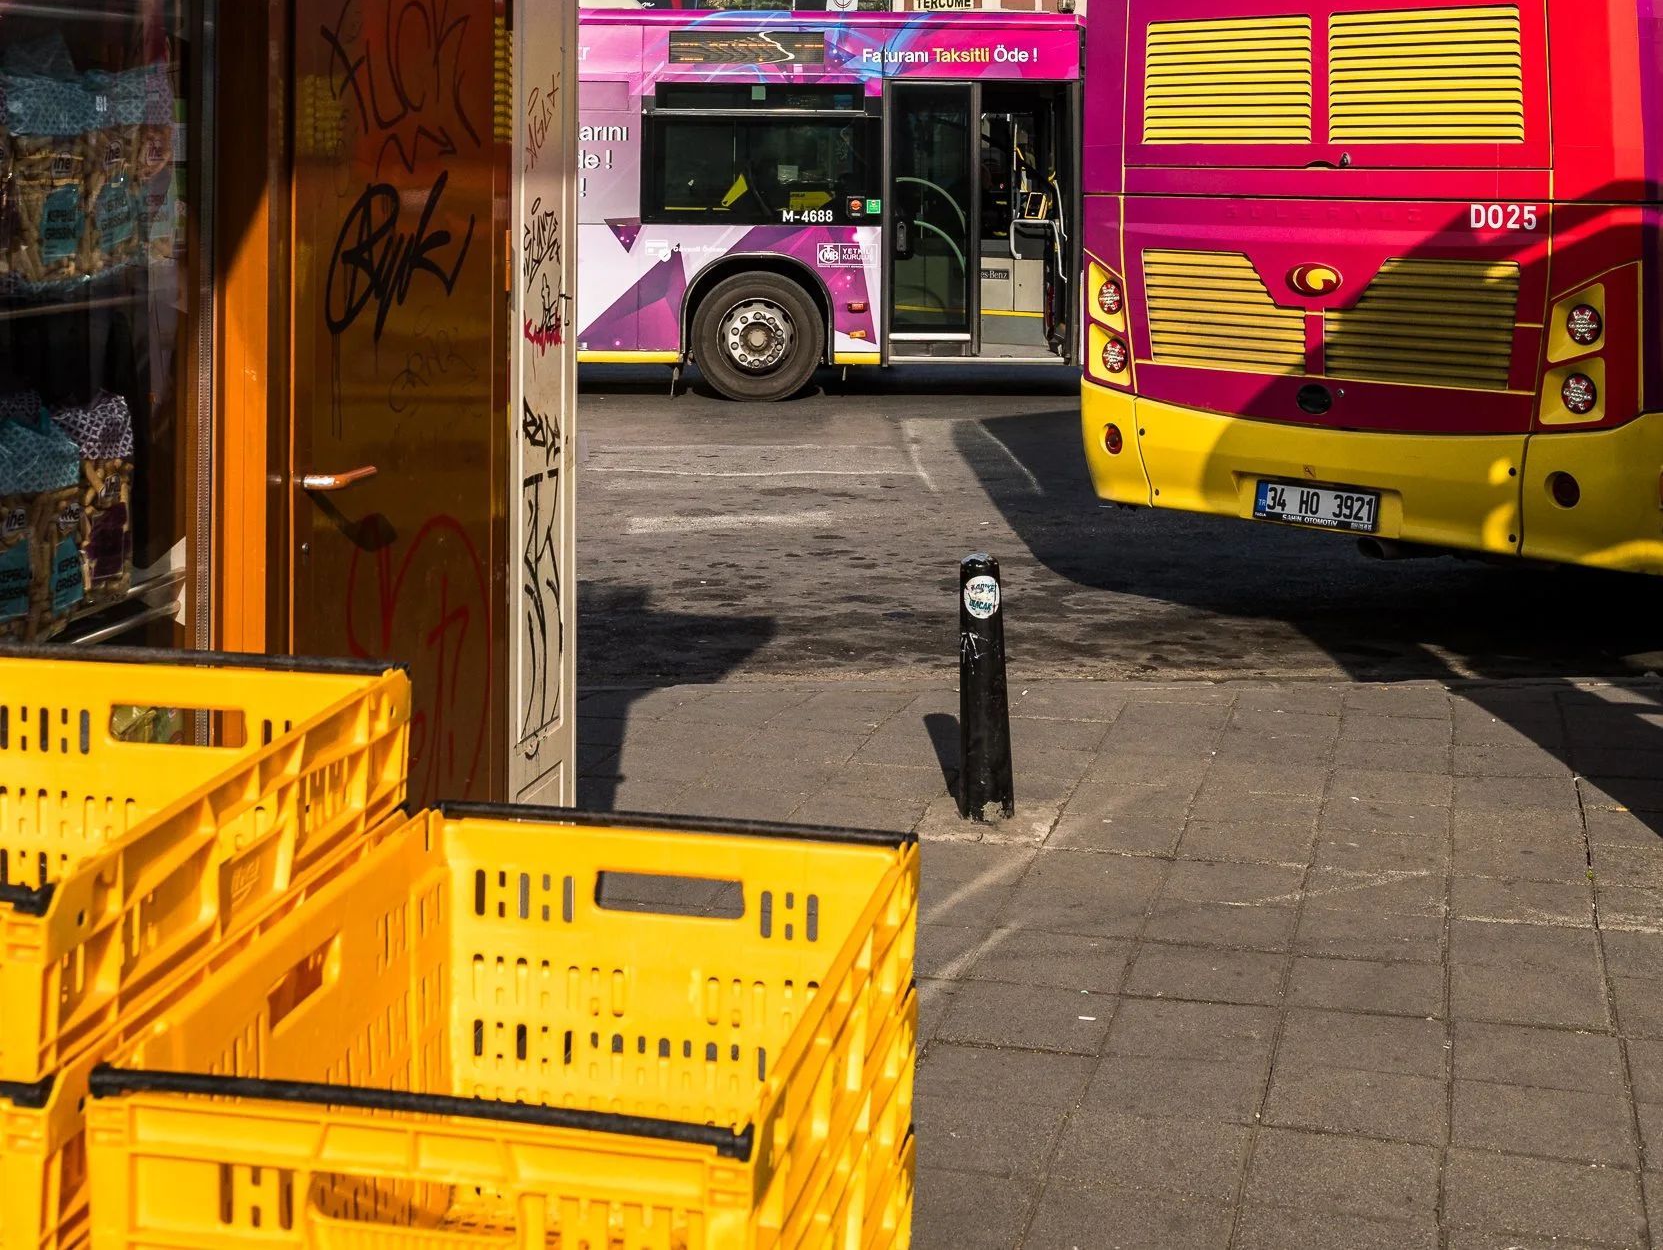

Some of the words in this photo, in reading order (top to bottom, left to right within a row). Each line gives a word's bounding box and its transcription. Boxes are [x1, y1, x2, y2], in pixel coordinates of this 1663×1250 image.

[862, 48, 929, 63] Faturanı
[932, 47, 989, 63] Taksitli
[993, 44, 1029, 63] Öde
[579, 123, 630, 142] arını
[782, 209, 833, 223] M-4688
[1258, 498, 1266, 506] TR
[1266, 486, 1287, 512] 34
[1298, 489, 1320, 516] HO
[1332, 493, 1374, 522] 3921
